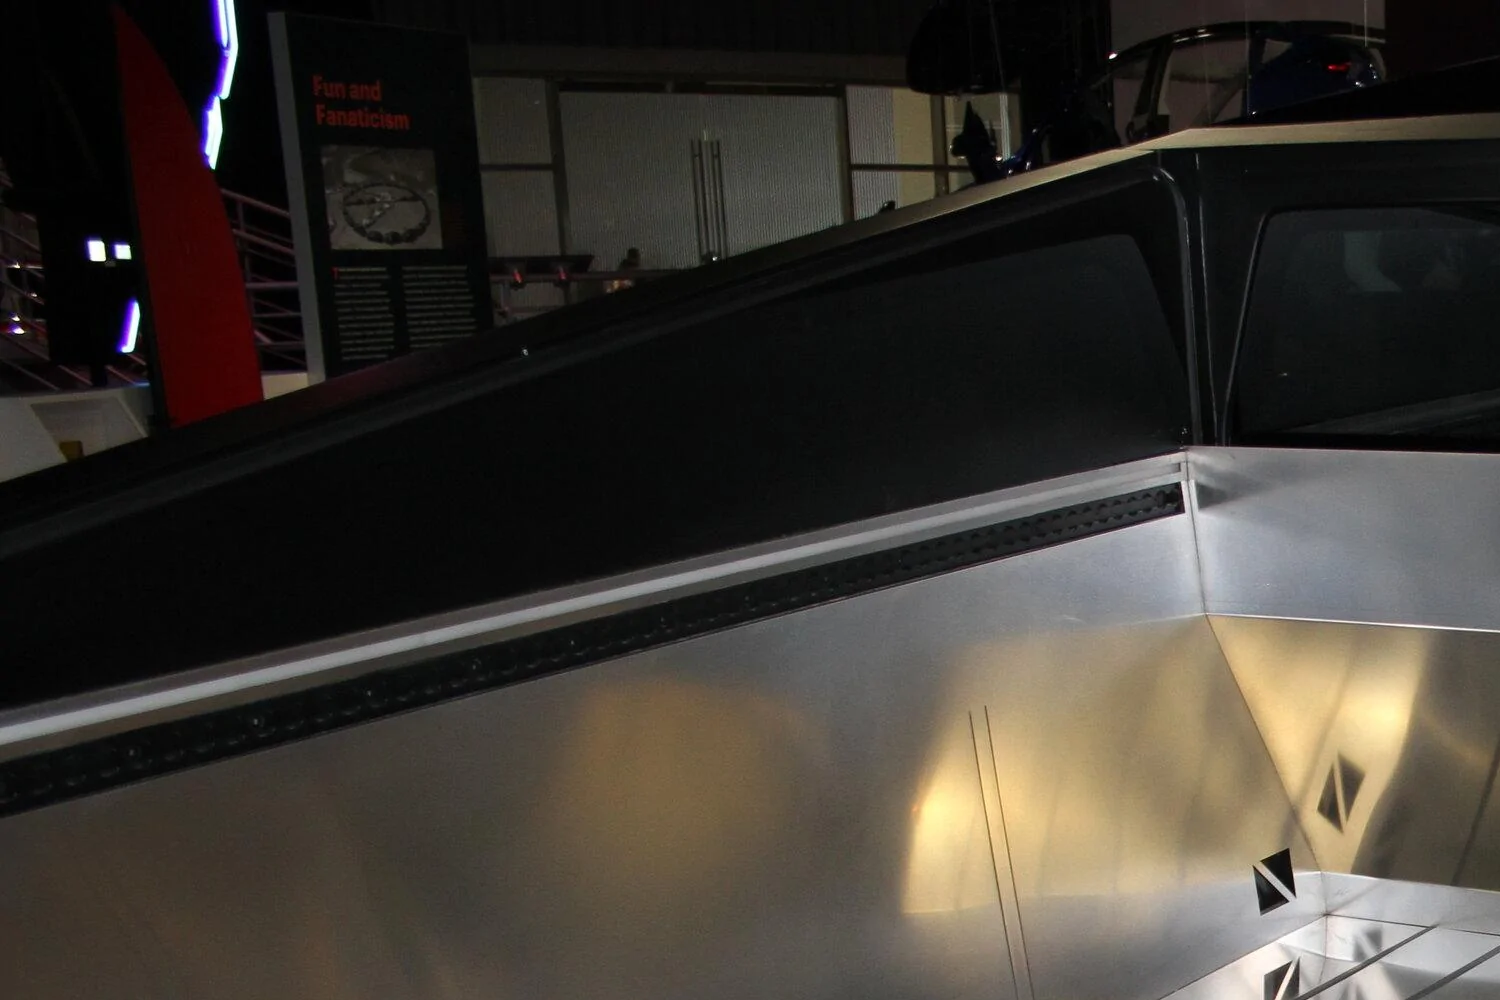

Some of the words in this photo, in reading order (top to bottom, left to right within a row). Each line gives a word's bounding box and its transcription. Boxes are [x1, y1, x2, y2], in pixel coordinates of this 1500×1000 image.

[311, 74, 346, 98] Fun
[350, 80, 382, 101] and
[315, 104, 410, 130] Fanaticism
